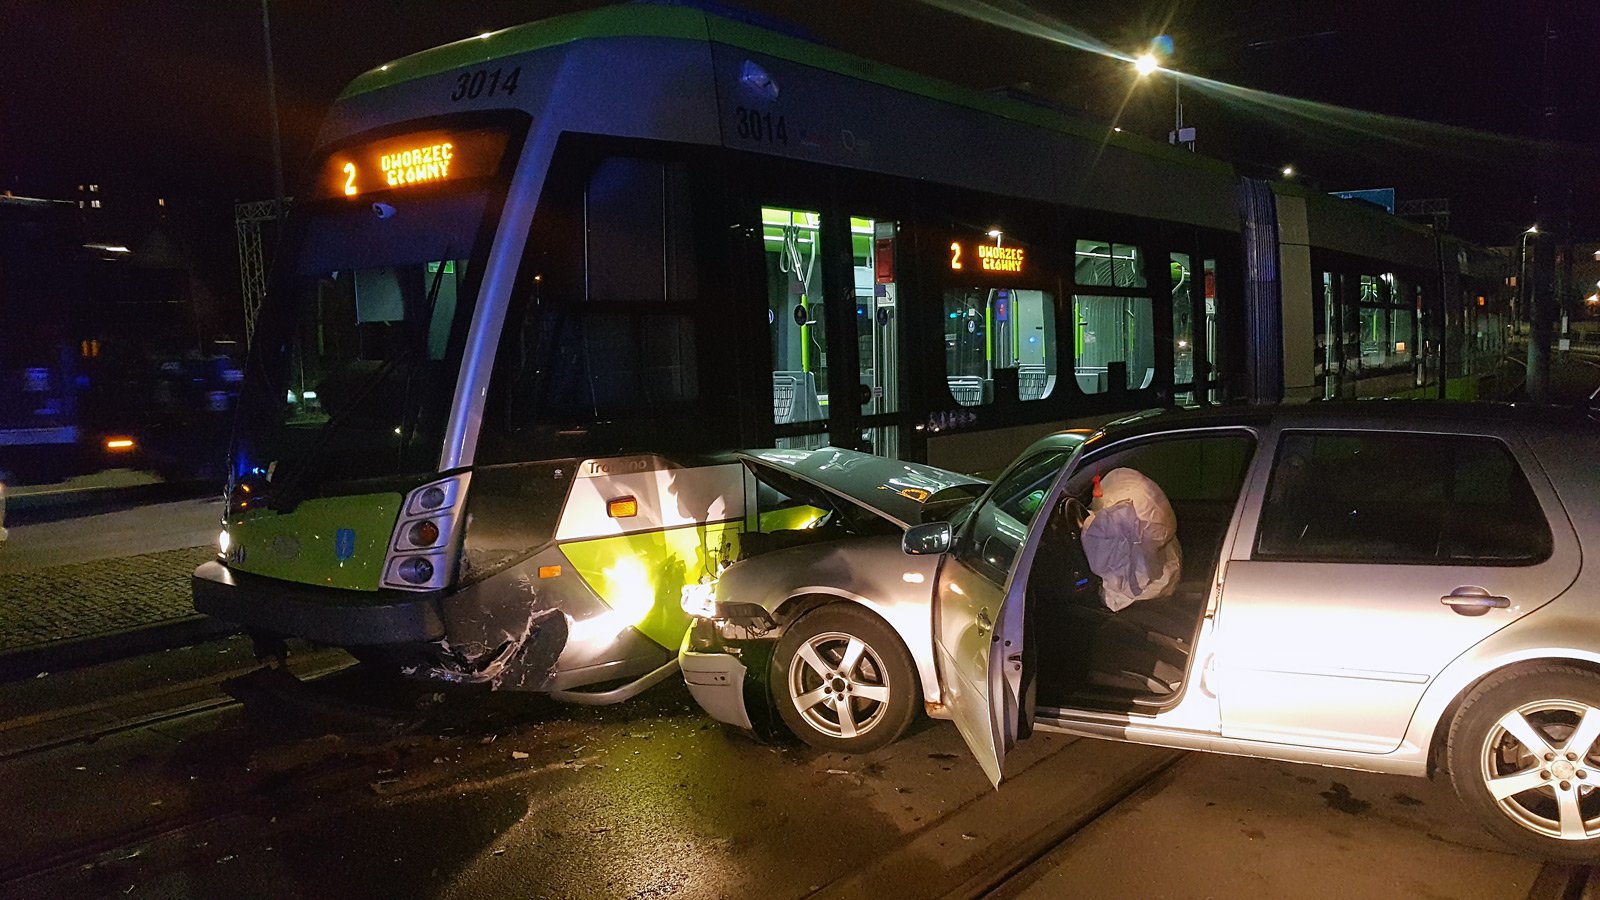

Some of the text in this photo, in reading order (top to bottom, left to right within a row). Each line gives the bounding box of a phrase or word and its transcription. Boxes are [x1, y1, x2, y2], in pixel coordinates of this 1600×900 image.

[452, 67, 521, 101] 3014
[736, 106, 788, 145] 3014
[381, 142, 453, 172] DWORZEC
[343, 162, 357, 196] 2
[950, 242, 962, 269] 2
[978, 245, 1024, 260] DWORZEC
[587, 460, 648, 474] Trano
